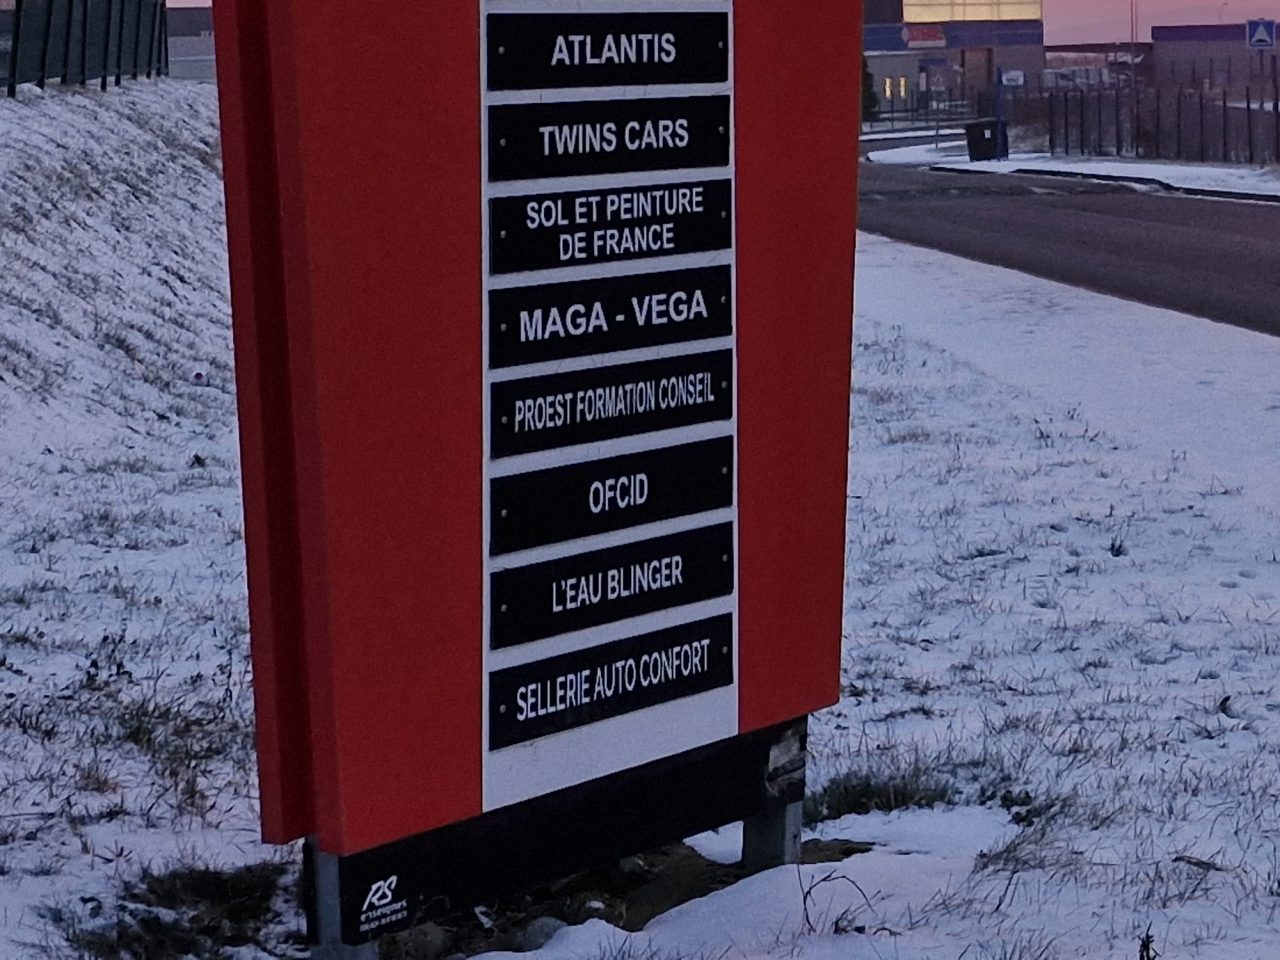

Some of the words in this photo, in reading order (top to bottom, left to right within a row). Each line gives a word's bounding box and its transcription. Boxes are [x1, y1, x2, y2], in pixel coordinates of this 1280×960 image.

[551, 33, 676, 66] ATLANTIS
[539, 123, 616, 156] TWINS
[625, 118, 689, 150] CARS
[526, 200, 569, 229] SOL
[575, 196, 601, 224] ET
[607, 187, 704, 221] PEINTURE
[560, 232, 587, 261] DE
[594, 223, 675, 257] FRANCE
[520, 302, 608, 342] MAGA
[632, 290, 708, 326] VEGA
[515, 393, 573, 432] PROEST
[576, 380, 655, 423] FORMATION
[659, 372, 714, 409] CONSEIL
[589, 473, 648, 514] OFCID
[552, 572, 602, 613] L'EAU
[607, 555, 683, 600] BLINGER
[517, 669, 591, 721] SELLERIE
[593, 658, 636, 701] AUTO
[640, 639, 710, 687] CONFORT
